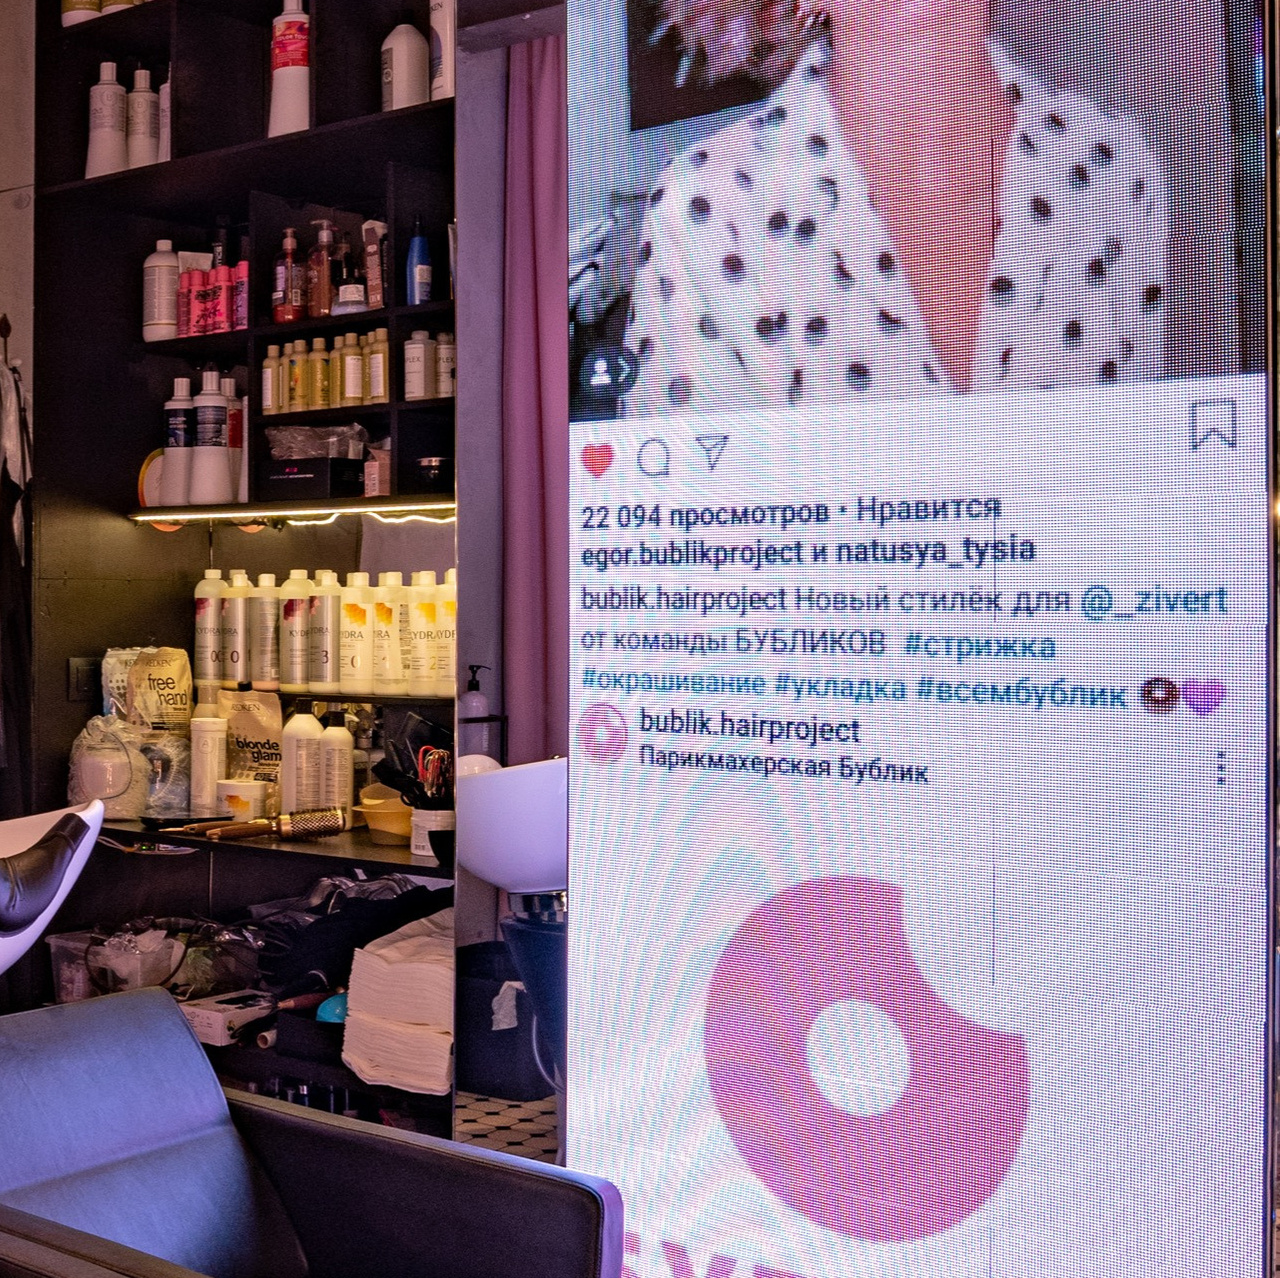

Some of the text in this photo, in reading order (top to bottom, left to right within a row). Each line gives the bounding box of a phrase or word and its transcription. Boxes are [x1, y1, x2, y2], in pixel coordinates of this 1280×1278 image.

[582, 495, 1003, 533] 22 094 просмотров Нравится
[581, 533, 1037, 571] egor.bublikproject и natusya_tysia
[581, 583, 1229, 621] bublik.hairproject Новый стилёк для @_zivert
[580, 628, 1057, 665] от команды БУБЛИКОВ #стрижка
[147, 673, 176, 691] free
[157, 689, 188, 706] hand
[582, 667, 1129, 710] #окрашивание #укладка #всембублик
[235, 737, 280, 751] blonde
[639, 706, 860, 746] bublik.hairproject
[251, 751, 283, 763] glam
[639, 744, 930, 784] Парикмахерская Бублик
